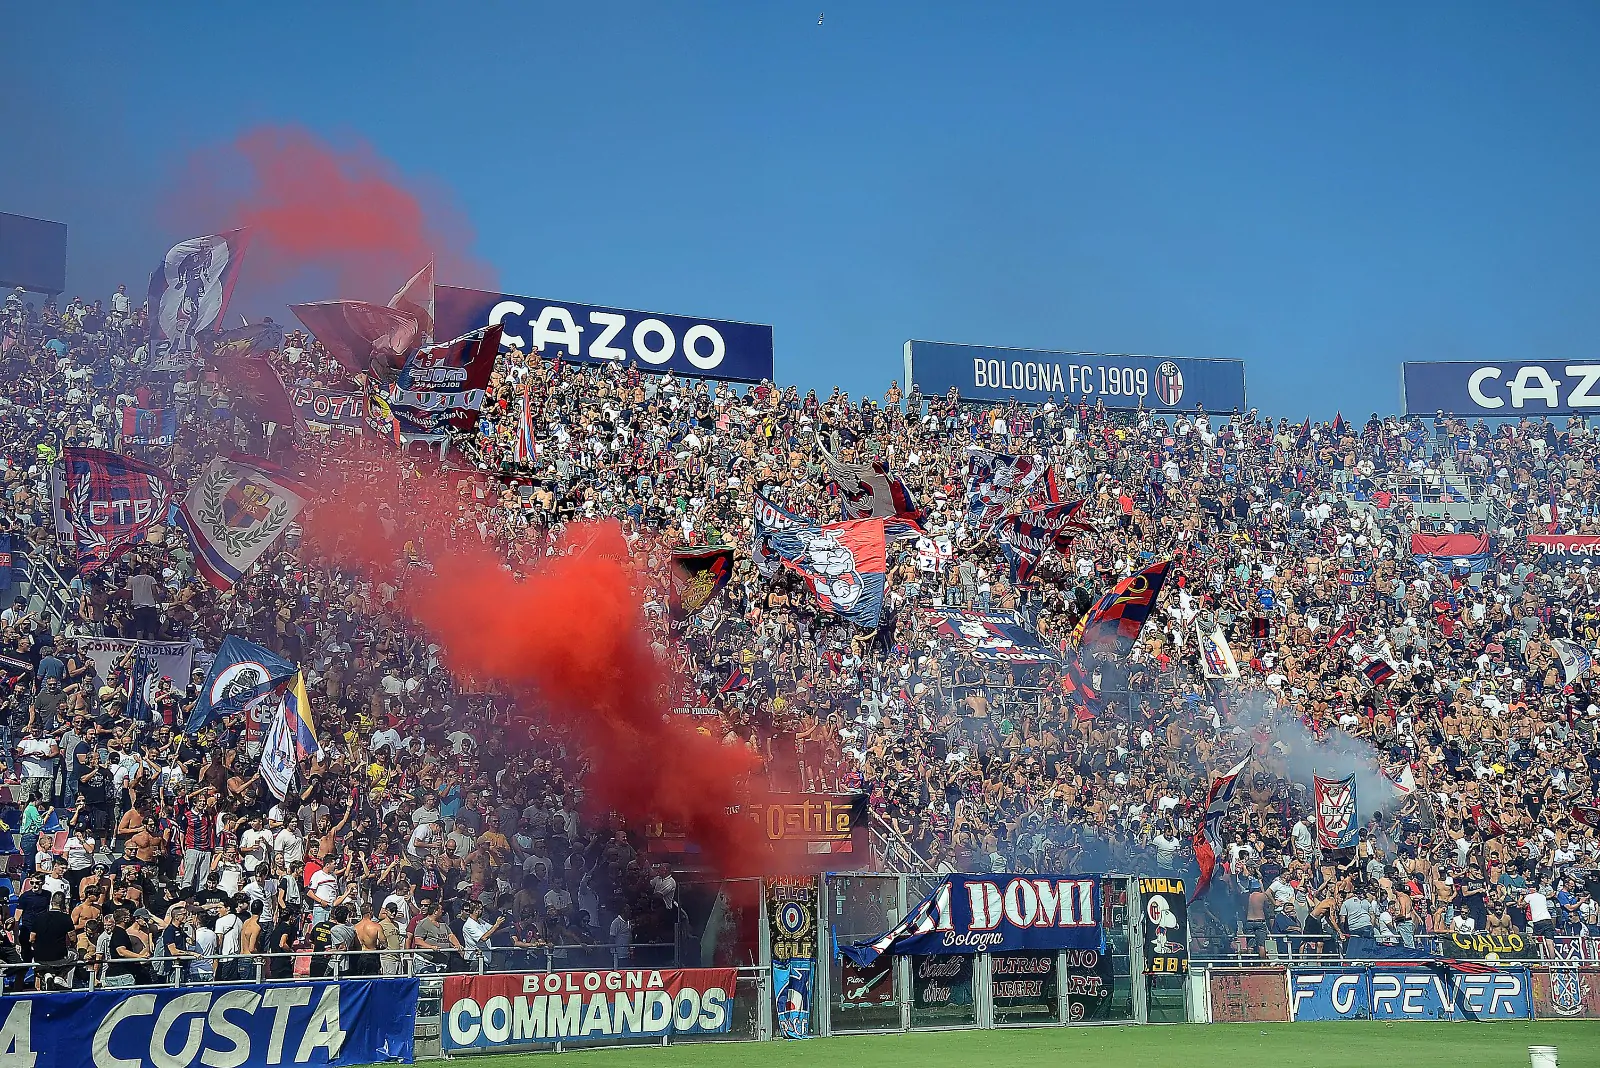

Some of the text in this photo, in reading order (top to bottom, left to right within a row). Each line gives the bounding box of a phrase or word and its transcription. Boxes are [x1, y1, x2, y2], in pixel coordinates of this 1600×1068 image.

[488, 301, 726, 370] CAZOO
[973, 358, 1148, 396] BOLOGNA FC 1909
[1467, 366, 1600, 409] CAZ
[89, 499, 152, 525] CTB
[1340, 572, 1365, 583] 40033
[971, 652, 1055, 661] OLOGNA
[766, 799, 850, 840] Ostile
[775, 887, 808, 901] FILA
[964, 877, 1096, 931] DOMI
[942, 930, 1004, 951] Bologna
[1452, 933, 1524, 953] GIALLO
[523, 970, 664, 993] BOLOGNA
[92, 984, 346, 1068] COSTA
[448, 986, 727, 1046] COMMANDOS
